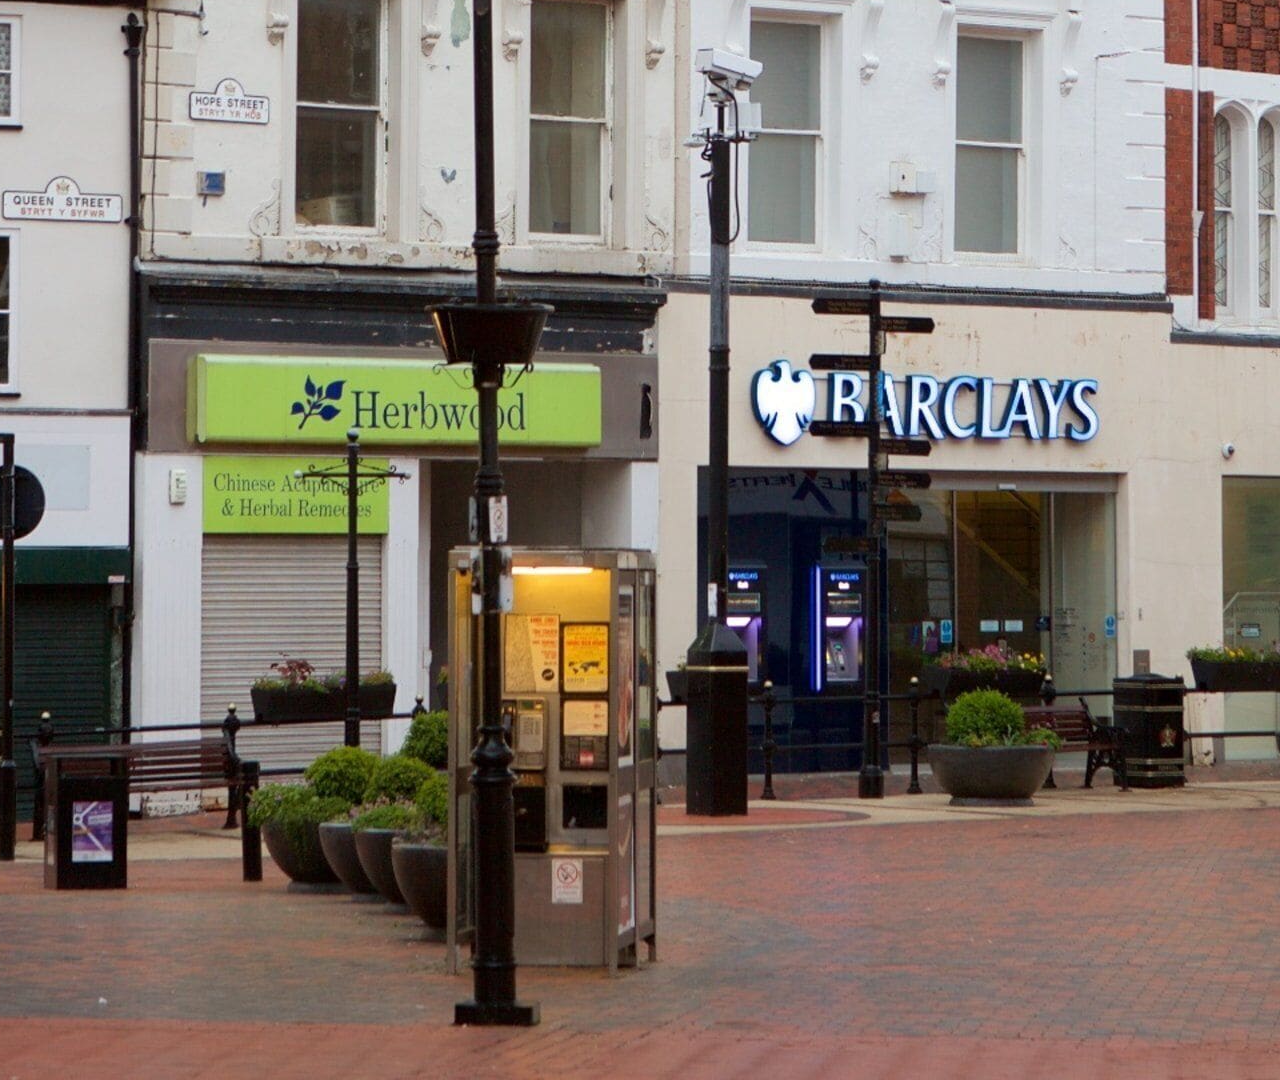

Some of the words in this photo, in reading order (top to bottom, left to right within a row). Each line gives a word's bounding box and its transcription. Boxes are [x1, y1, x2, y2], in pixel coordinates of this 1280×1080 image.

[195, 96, 222, 108] HOPE
[227, 98, 265, 110] STREET
[198, 107, 226, 117] STRYT
[229, 108, 241, 118] YR
[13, 195, 54, 206] QUEEN
[66, 196, 112, 208] STREET
[20, 207, 53, 217] STRYT
[59, 208, 66, 217] Y
[70, 208, 105, 218] SYFWR
[829, 371, 1101, 443] BARCLAYS
[213, 473, 276, 493] Chinese
[221, 500, 235, 517] &
[240, 498, 293, 517] Herbal
[298, 500, 372, 519] Remees
